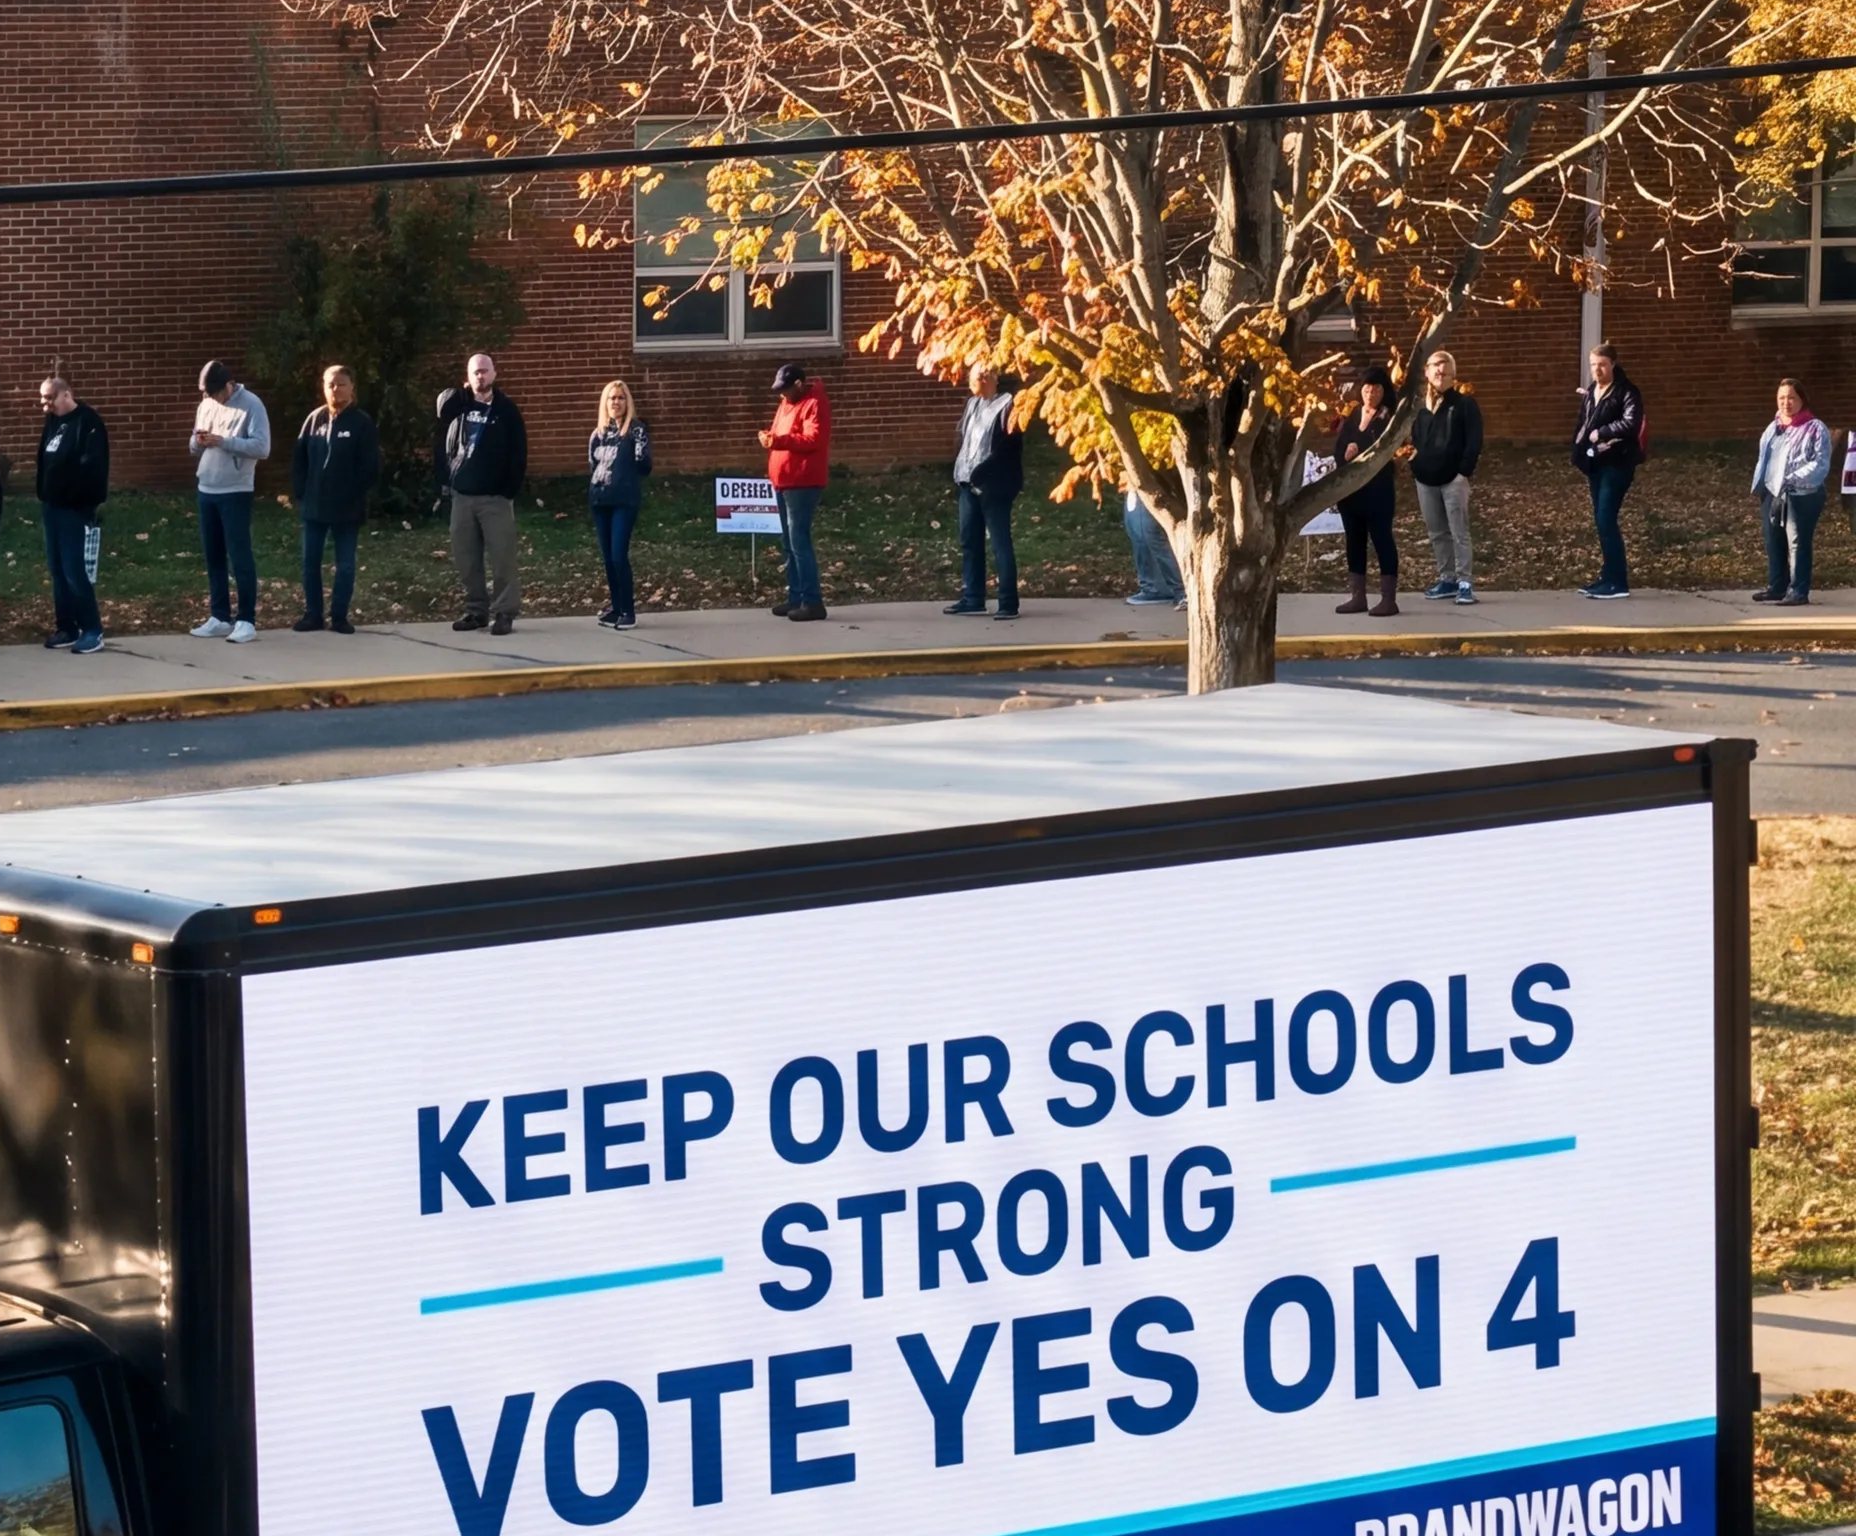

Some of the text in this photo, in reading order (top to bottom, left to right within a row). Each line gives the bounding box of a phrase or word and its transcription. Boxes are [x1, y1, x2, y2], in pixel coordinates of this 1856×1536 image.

[417, 962, 1574, 1216] KEEP OUR SCHOOLS
[759, 1145, 1235, 1312] STRONG
[895, 1295, 1199, 1468] YES
[1243, 1254, 1442, 1414] ON
[1486, 1236, 1576, 1370] 4
